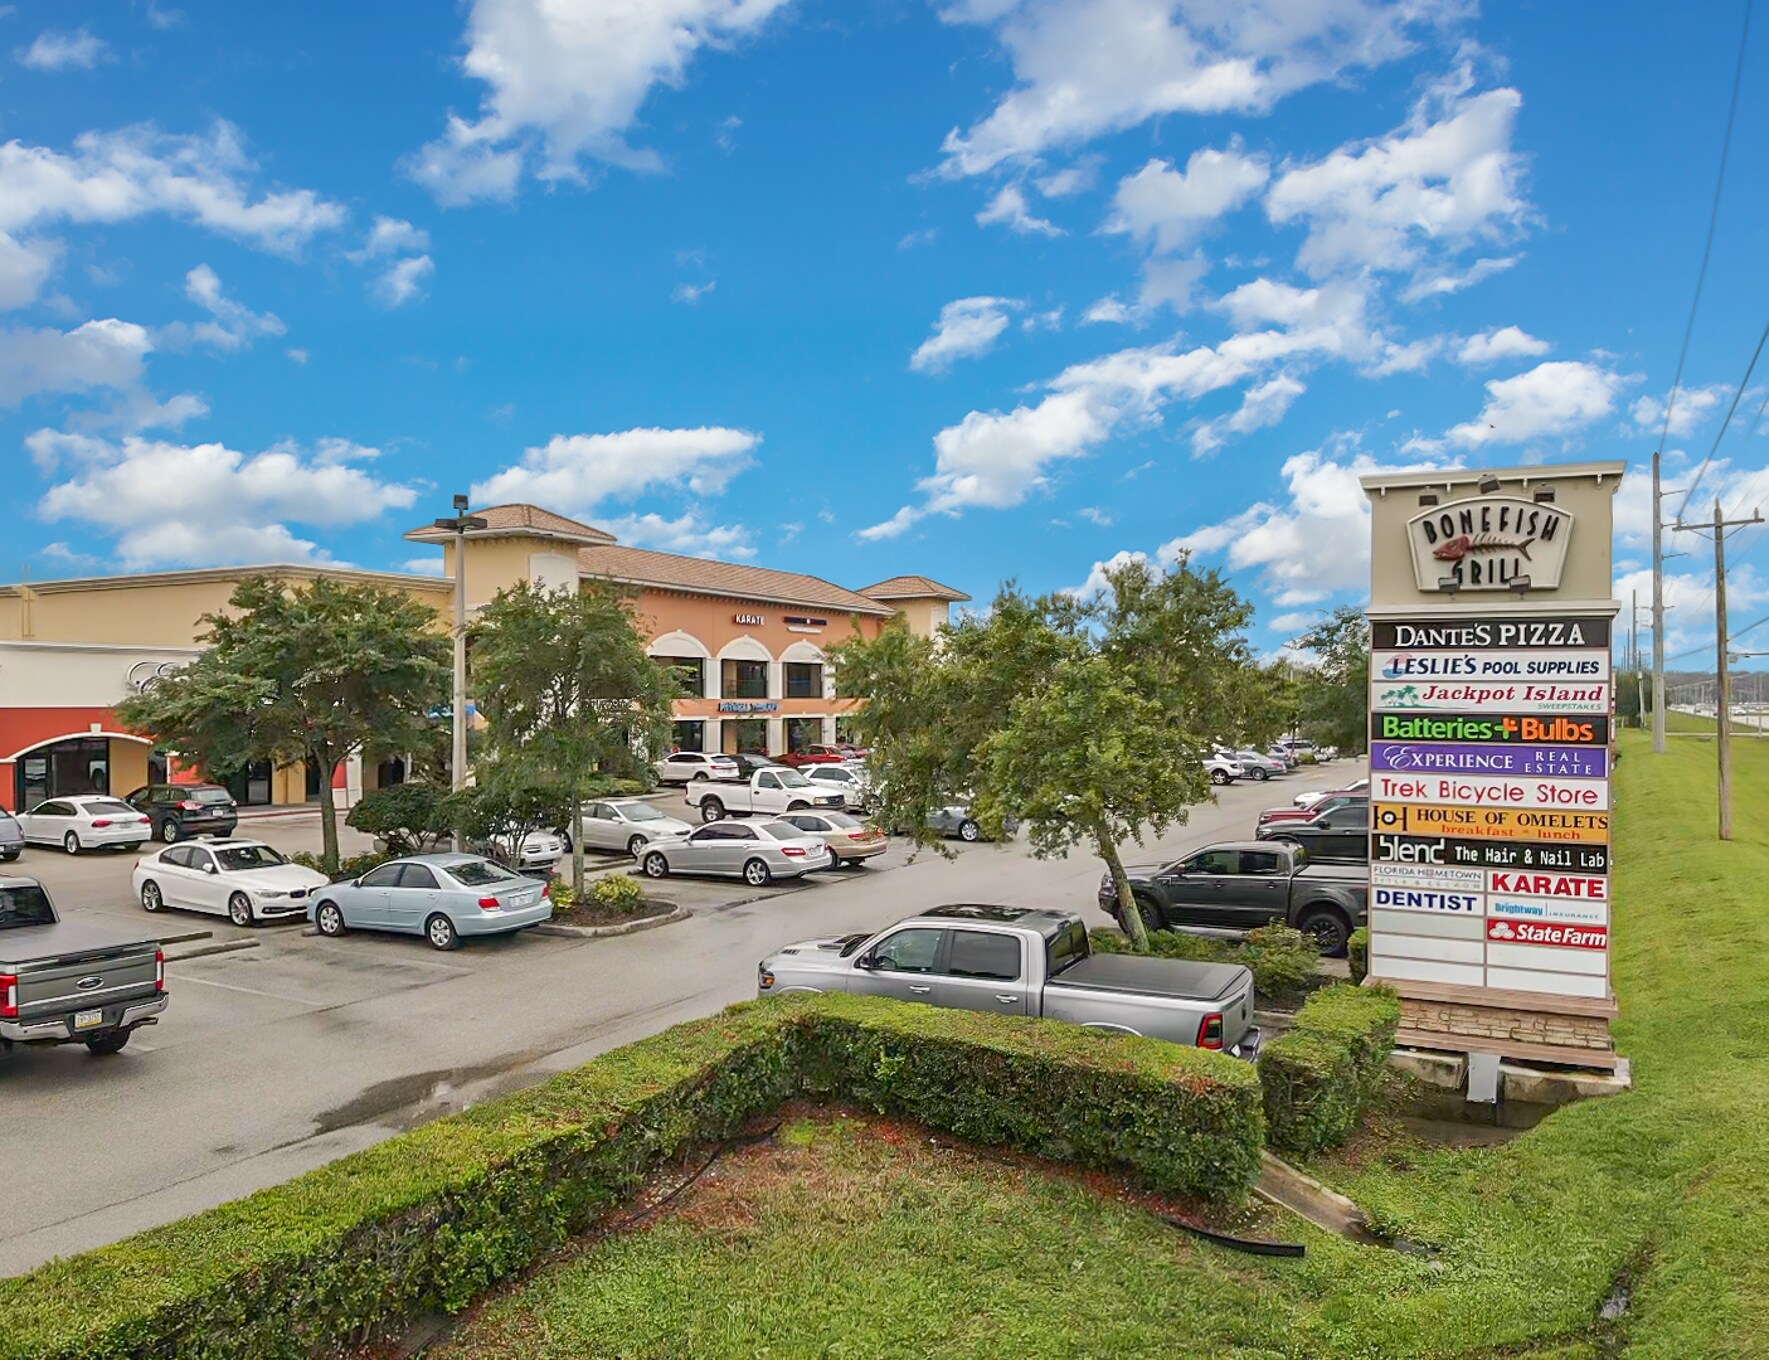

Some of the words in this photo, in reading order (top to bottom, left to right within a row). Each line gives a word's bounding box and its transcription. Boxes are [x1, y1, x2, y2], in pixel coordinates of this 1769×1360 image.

[1423, 506, 1560, 544] BONEFISH
[736, 614, 765, 625] KARATE
[1395, 623, 1491, 647] DANTE'S
[1499, 623, 1585, 646] PIZZA
[1392, 654, 1476, 675] LESLIE'S
[1482, 661, 1521, 674] POOL
[1526, 661, 1599, 674] SUPPLIES
[1422, 685, 1515, 704] Jackpot
[1522, 686, 1603, 702] Island
[1537, 702, 1602, 711] SWEEPSTAKES
[1383, 745, 1513, 770] EXPERIENCE
[1535, 751, 1580, 763] REAL
[1525, 763, 1592, 775] ESTATE
[1381, 778, 1427, 798] Trek
[1440, 781, 1524, 805] Bicycle
[1537, 784, 1598, 804] Store
[1417, 808, 1476, 823] HOUSE
[1485, 810, 1507, 825] OF
[1517, 812, 1608, 829] OMELETS
[1441, 824, 1514, 837] breakfast
[1538, 829, 1581, 840] lunch
[1379, 834, 1445, 864] blend
[1455, 846, 1478, 862] The
[1485, 848, 1517, 864] Hair
[1524, 850, 1533, 864] &
[1540, 850, 1572, 866] Nail
[1581, 853, 1605, 868] Lab
[1374, 865, 1415, 875] FLORIDA
[1492, 873, 1604, 898] KARATE
[1376, 890, 1477, 911] DENTIST
[1495, 902, 1543, 916] Brightway
[1549, 911, 1600, 920] INSURANCE
